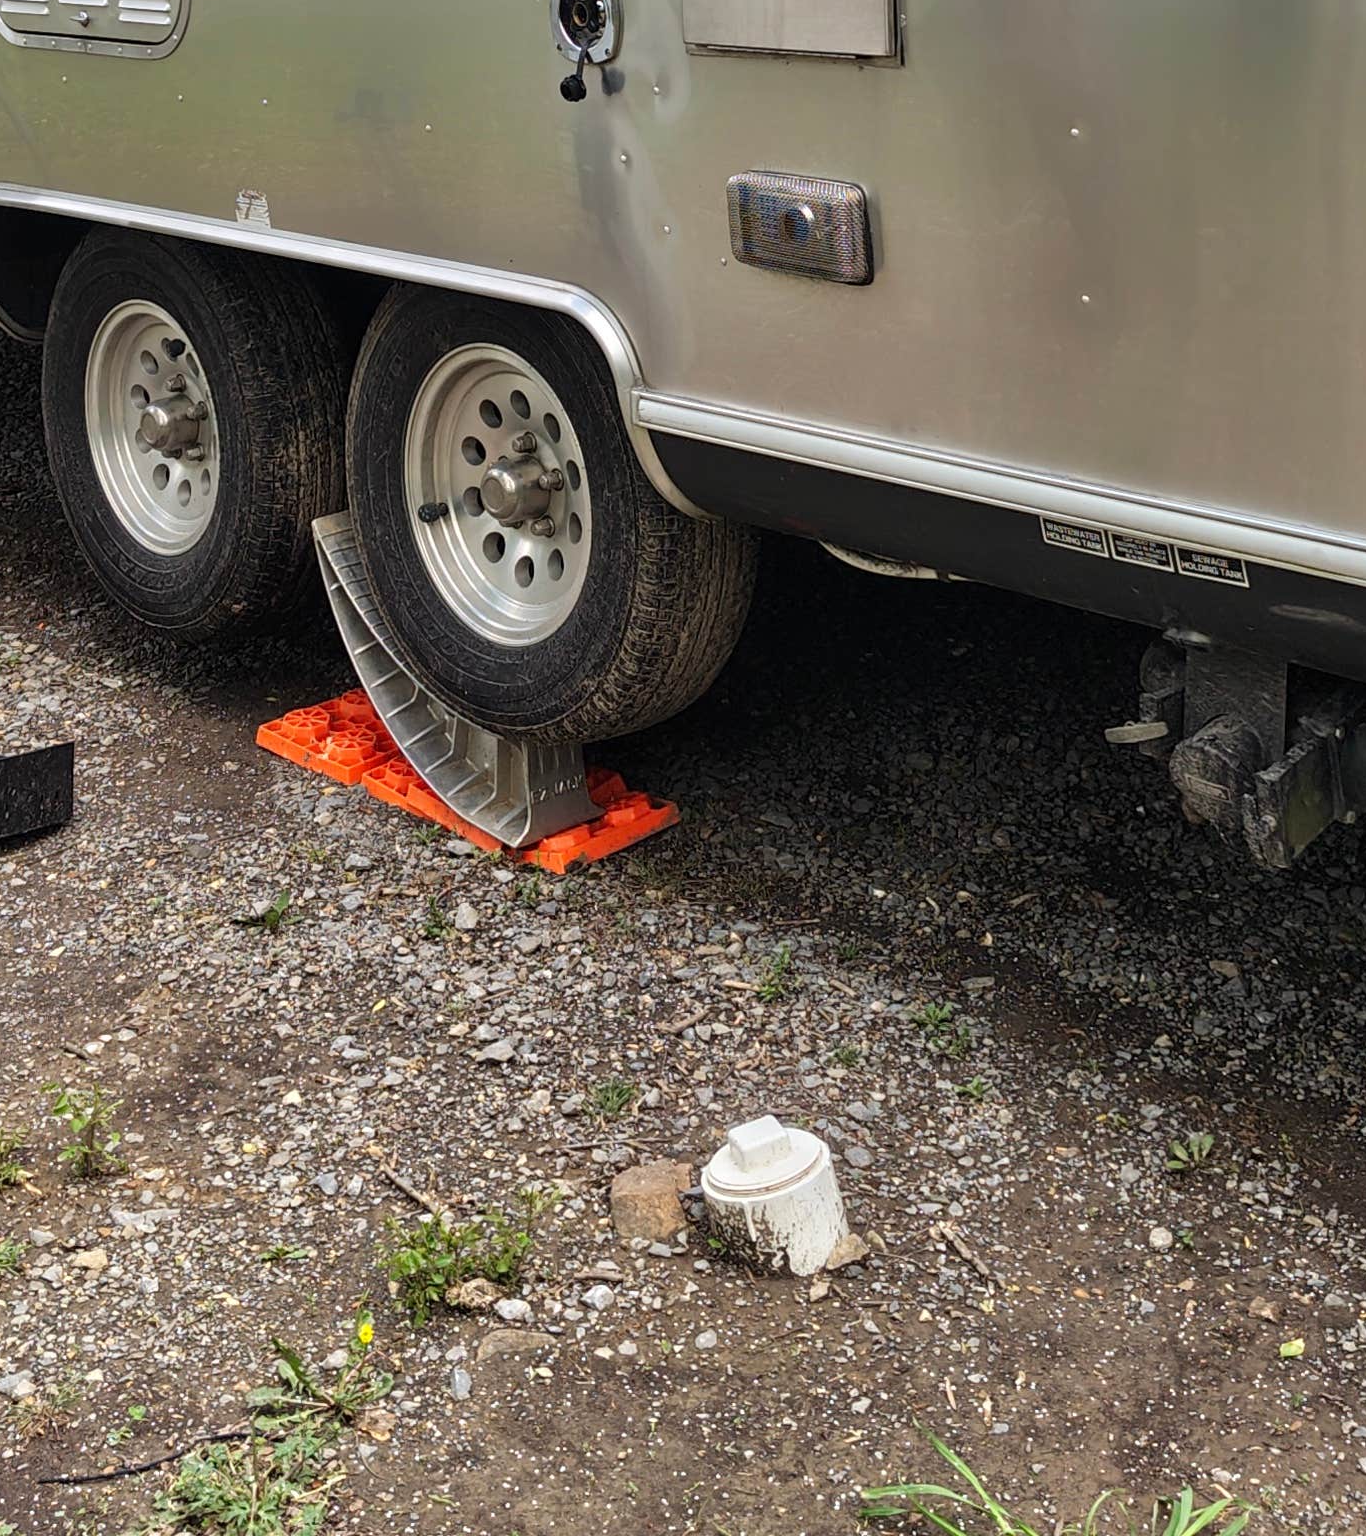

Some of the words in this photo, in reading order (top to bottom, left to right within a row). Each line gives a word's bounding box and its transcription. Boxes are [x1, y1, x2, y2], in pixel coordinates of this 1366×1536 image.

[1045, 522, 1101, 541] WASTEWATER
[1046, 531, 1081, 547] HOLDING
[1081, 539, 1102, 550] TANK
[1180, 560, 1219, 576] HOLDING
[1220, 568, 1244, 580] TANK
[1191, 553, 1229, 568] SEWAGE
